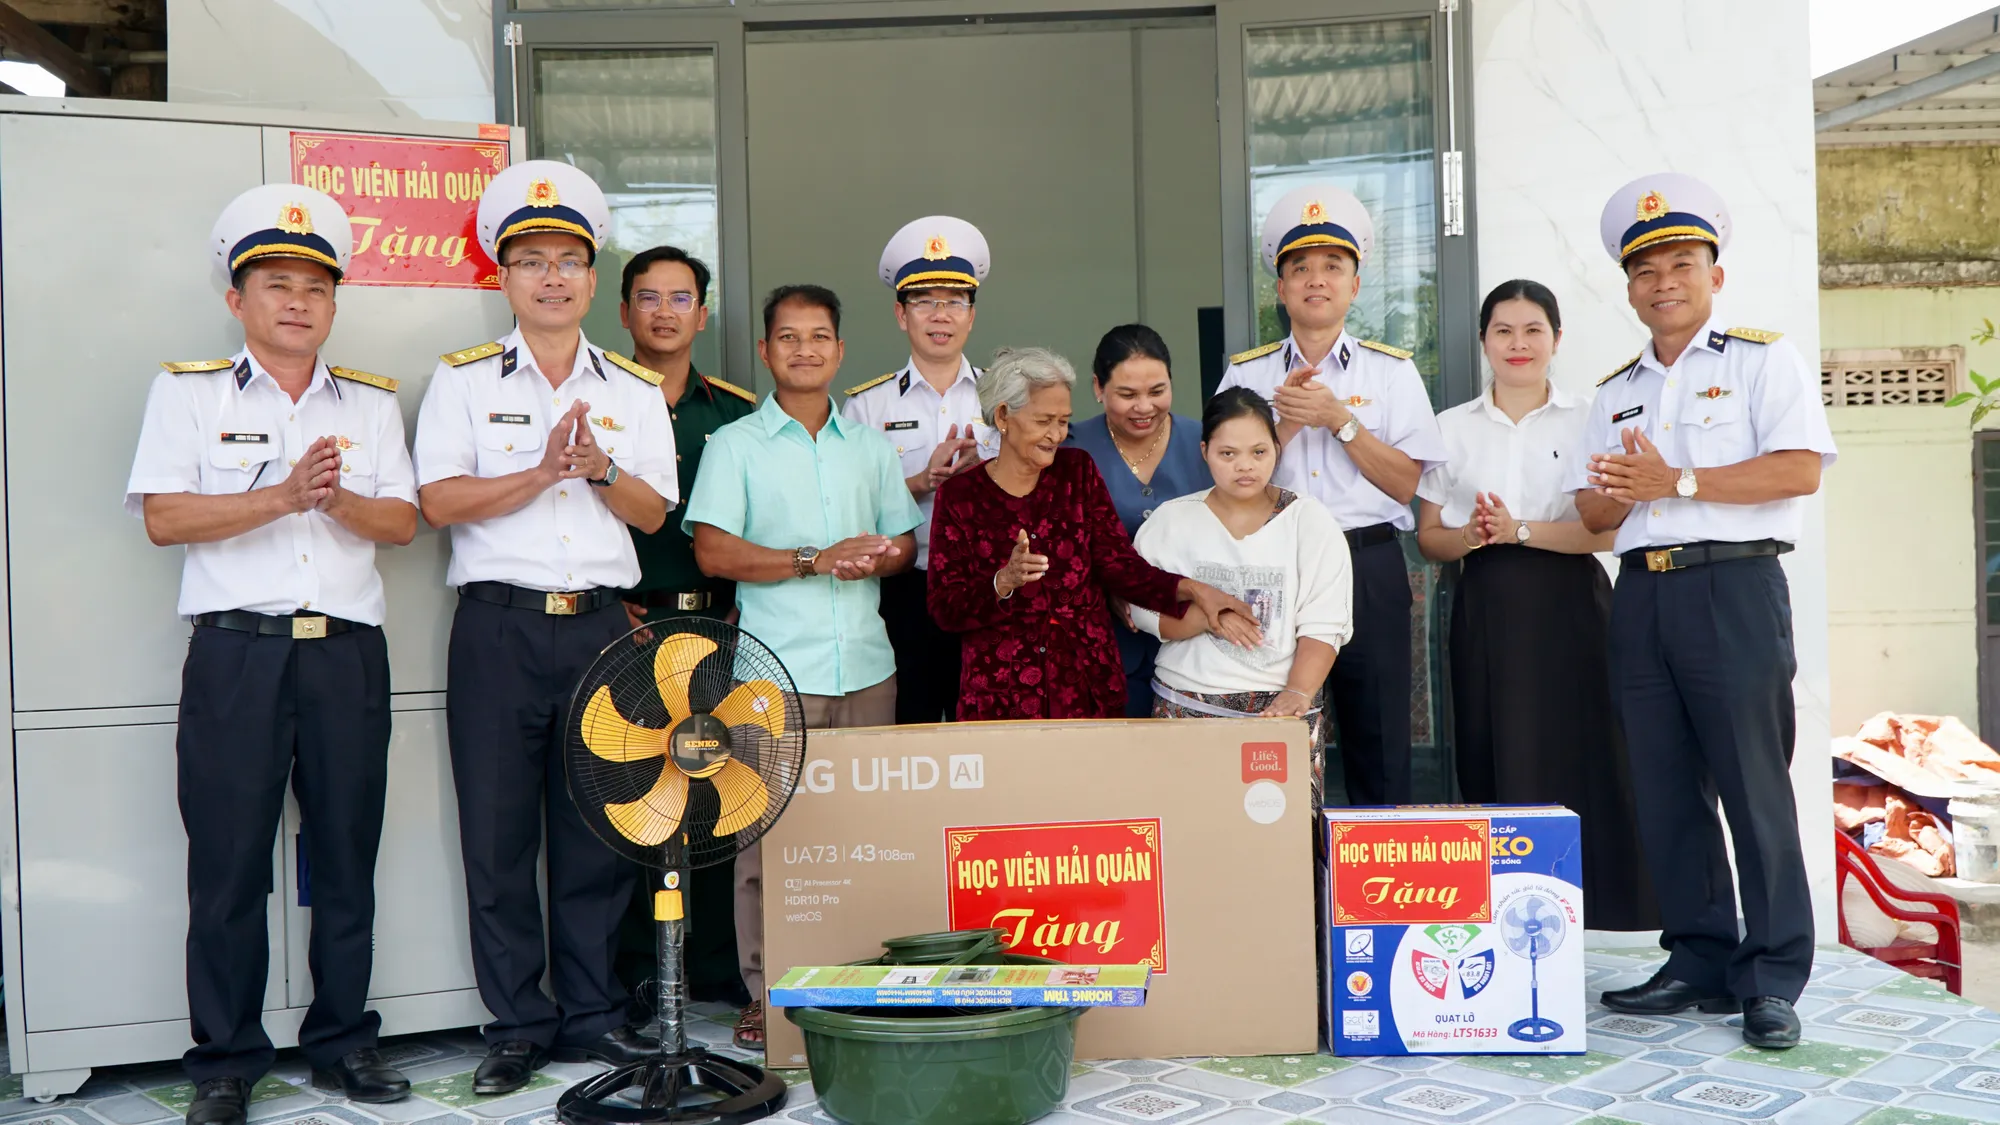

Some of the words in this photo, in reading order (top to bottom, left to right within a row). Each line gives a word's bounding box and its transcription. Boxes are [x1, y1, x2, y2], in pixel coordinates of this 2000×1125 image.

[351, 162, 398, 203] VIỆN
[404, 161, 438, 199] HẢI
[350, 216, 471, 267] Tặng
[684, 740, 719, 748] SENKO
[1252, 750, 1278, 761] Life's
[1250, 761, 1282, 772] Good.
[780, 759, 835, 794] LG
[852, 756, 940, 791] UHD
[954, 761, 979, 783] AI
[783, 845, 838, 864] UA73
[1339, 842, 1370, 867] HỌC
[1373, 838, 1407, 867] VIỆN
[1411, 835, 1437, 862] HẢI
[1441, 837, 1482, 864] QUÂN
[957, 858, 999, 895] HỌC
[1004, 851, 1050, 893] VIỆN
[1056, 845, 1090, 885] HẢI
[1095, 846, 1151, 886] QUÂN
[784, 895, 820, 905] HDR10
[822, 894, 840, 905] Pro
[1362, 877, 1461, 909] Tặng
[785, 911, 823, 922] webOS
[990, 908, 1124, 956] Tặng
[1072, 990, 1113, 1004] HOÀNG
[1435, 1014, 1461, 1025] QUẠT
[1453, 1027, 1498, 1038] LTS1633
